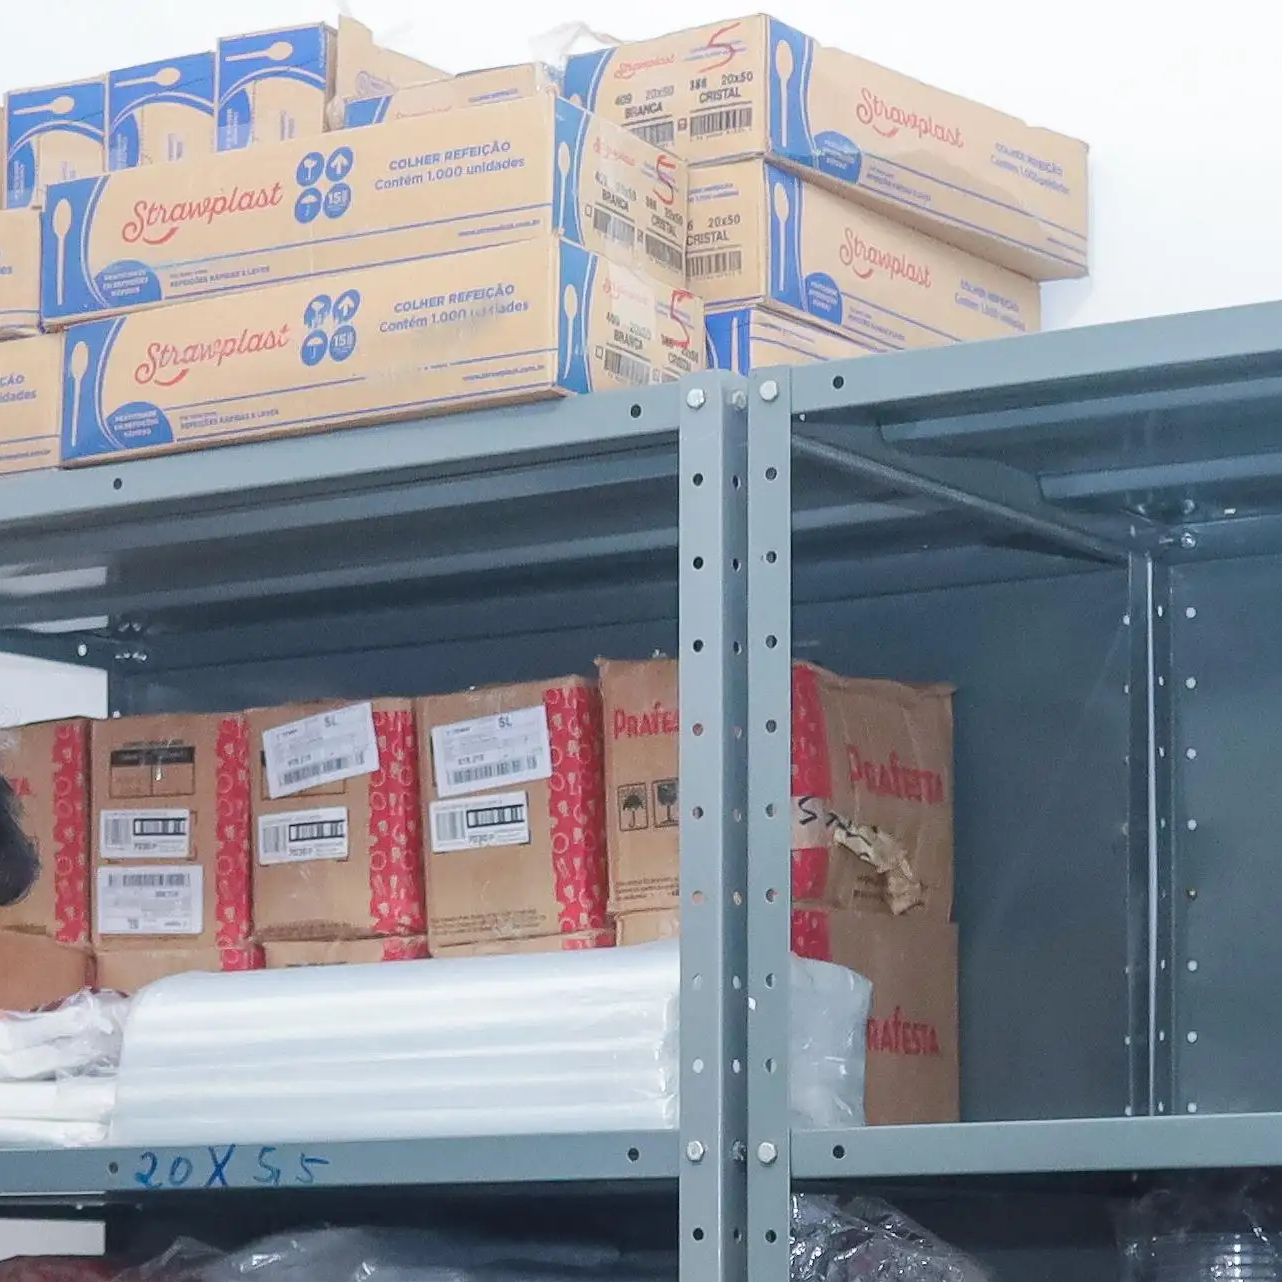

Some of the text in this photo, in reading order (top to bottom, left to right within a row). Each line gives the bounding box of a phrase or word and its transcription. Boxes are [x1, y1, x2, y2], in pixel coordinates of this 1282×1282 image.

[699, 86, 742, 103] CRISTAL
[855, 87, 964, 148] Strawplast
[375, 157, 525, 190] Contém 1.000 unidades
[389, 140, 511, 170] COLHER REFEIÇÃO
[122, 181, 283, 245] Strawplast
[839, 227, 931, 288] Strawplast
[394, 283, 515, 313] COLHER REFEIÇÃO
[379, 314, 427, 333] Contém
[431, 309, 466, 323] 1.000
[134, 324, 291, 386] Strawplast
[867, 1006, 940, 1056] RAFESTA
[133, 1150, 193, 1189] 20
